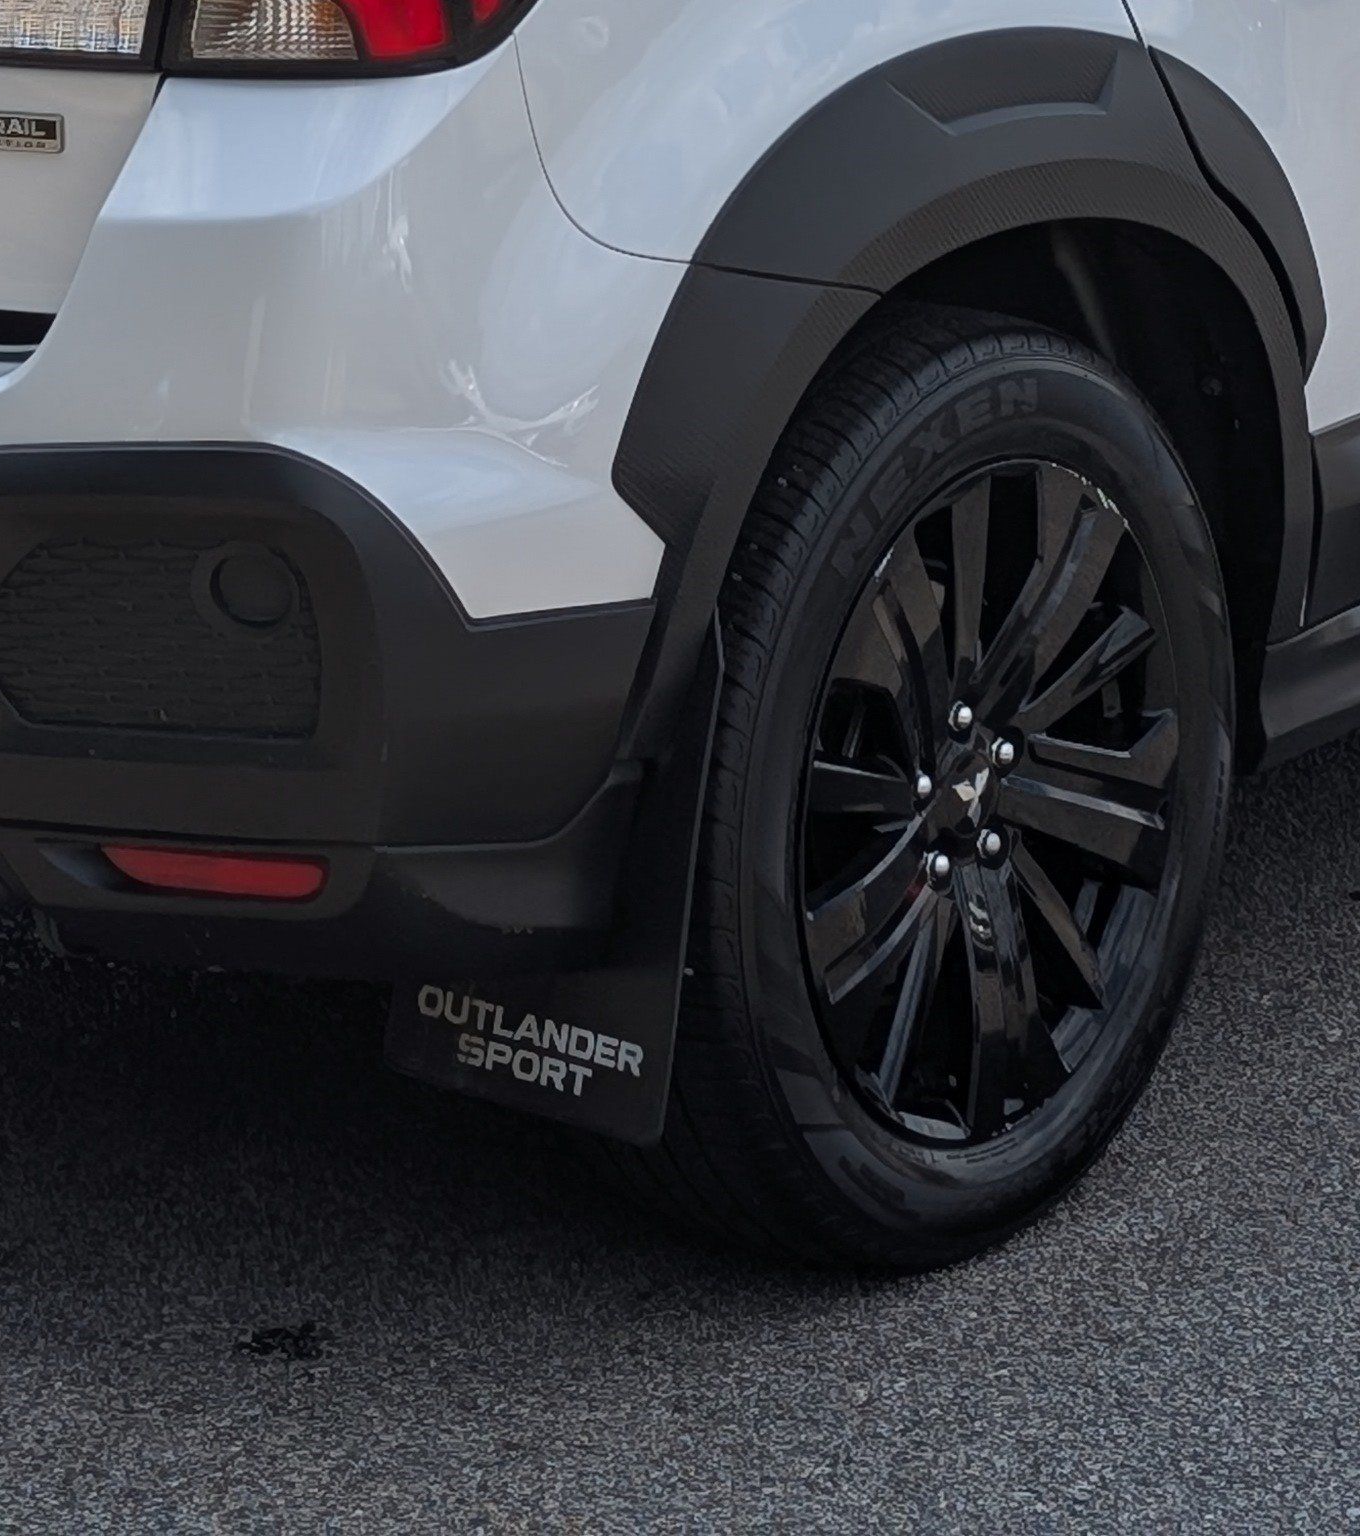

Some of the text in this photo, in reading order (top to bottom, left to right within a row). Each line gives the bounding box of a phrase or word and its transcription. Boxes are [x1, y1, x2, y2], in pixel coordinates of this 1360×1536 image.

[830, 376, 1039, 580] NEXEN
[417, 984, 644, 1077] OUTLANDER
[456, 1033, 593, 1097] SPORT
